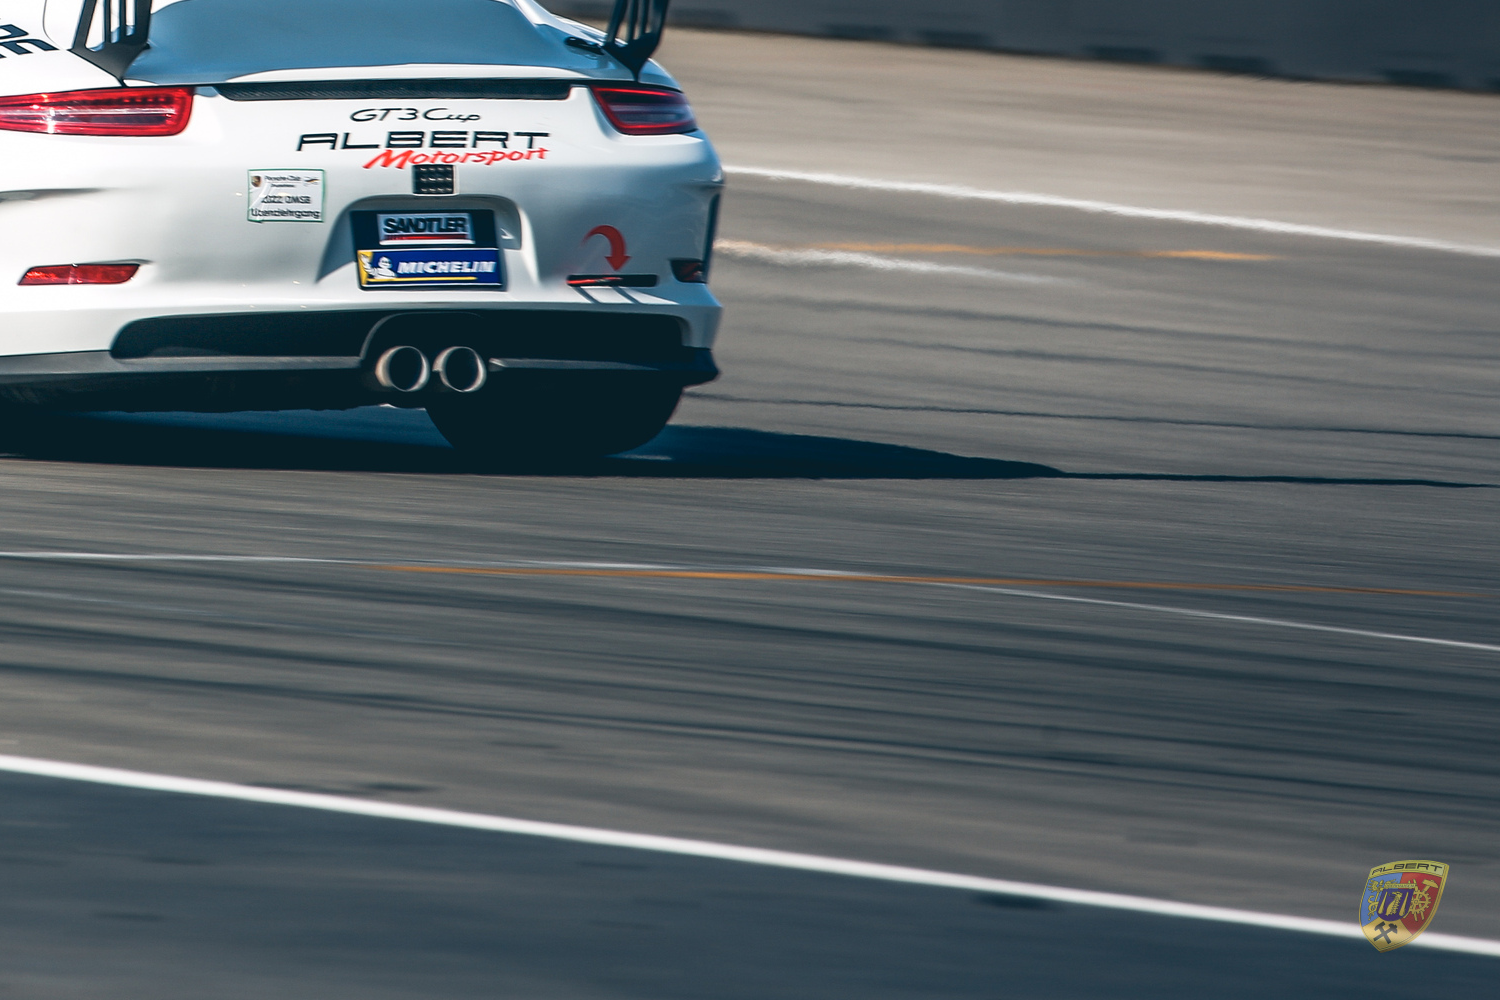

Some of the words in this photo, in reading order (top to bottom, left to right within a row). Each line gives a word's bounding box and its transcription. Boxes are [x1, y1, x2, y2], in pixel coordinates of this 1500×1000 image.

[350, 108, 418, 122] GT3
[423, 108, 481, 122] Cup
[296, 131, 550, 151] ALBERT
[362, 148, 550, 169] Motorsport
[383, 217, 467, 233] SANDTLER
[397, 261, 497, 274] MICHELIN
